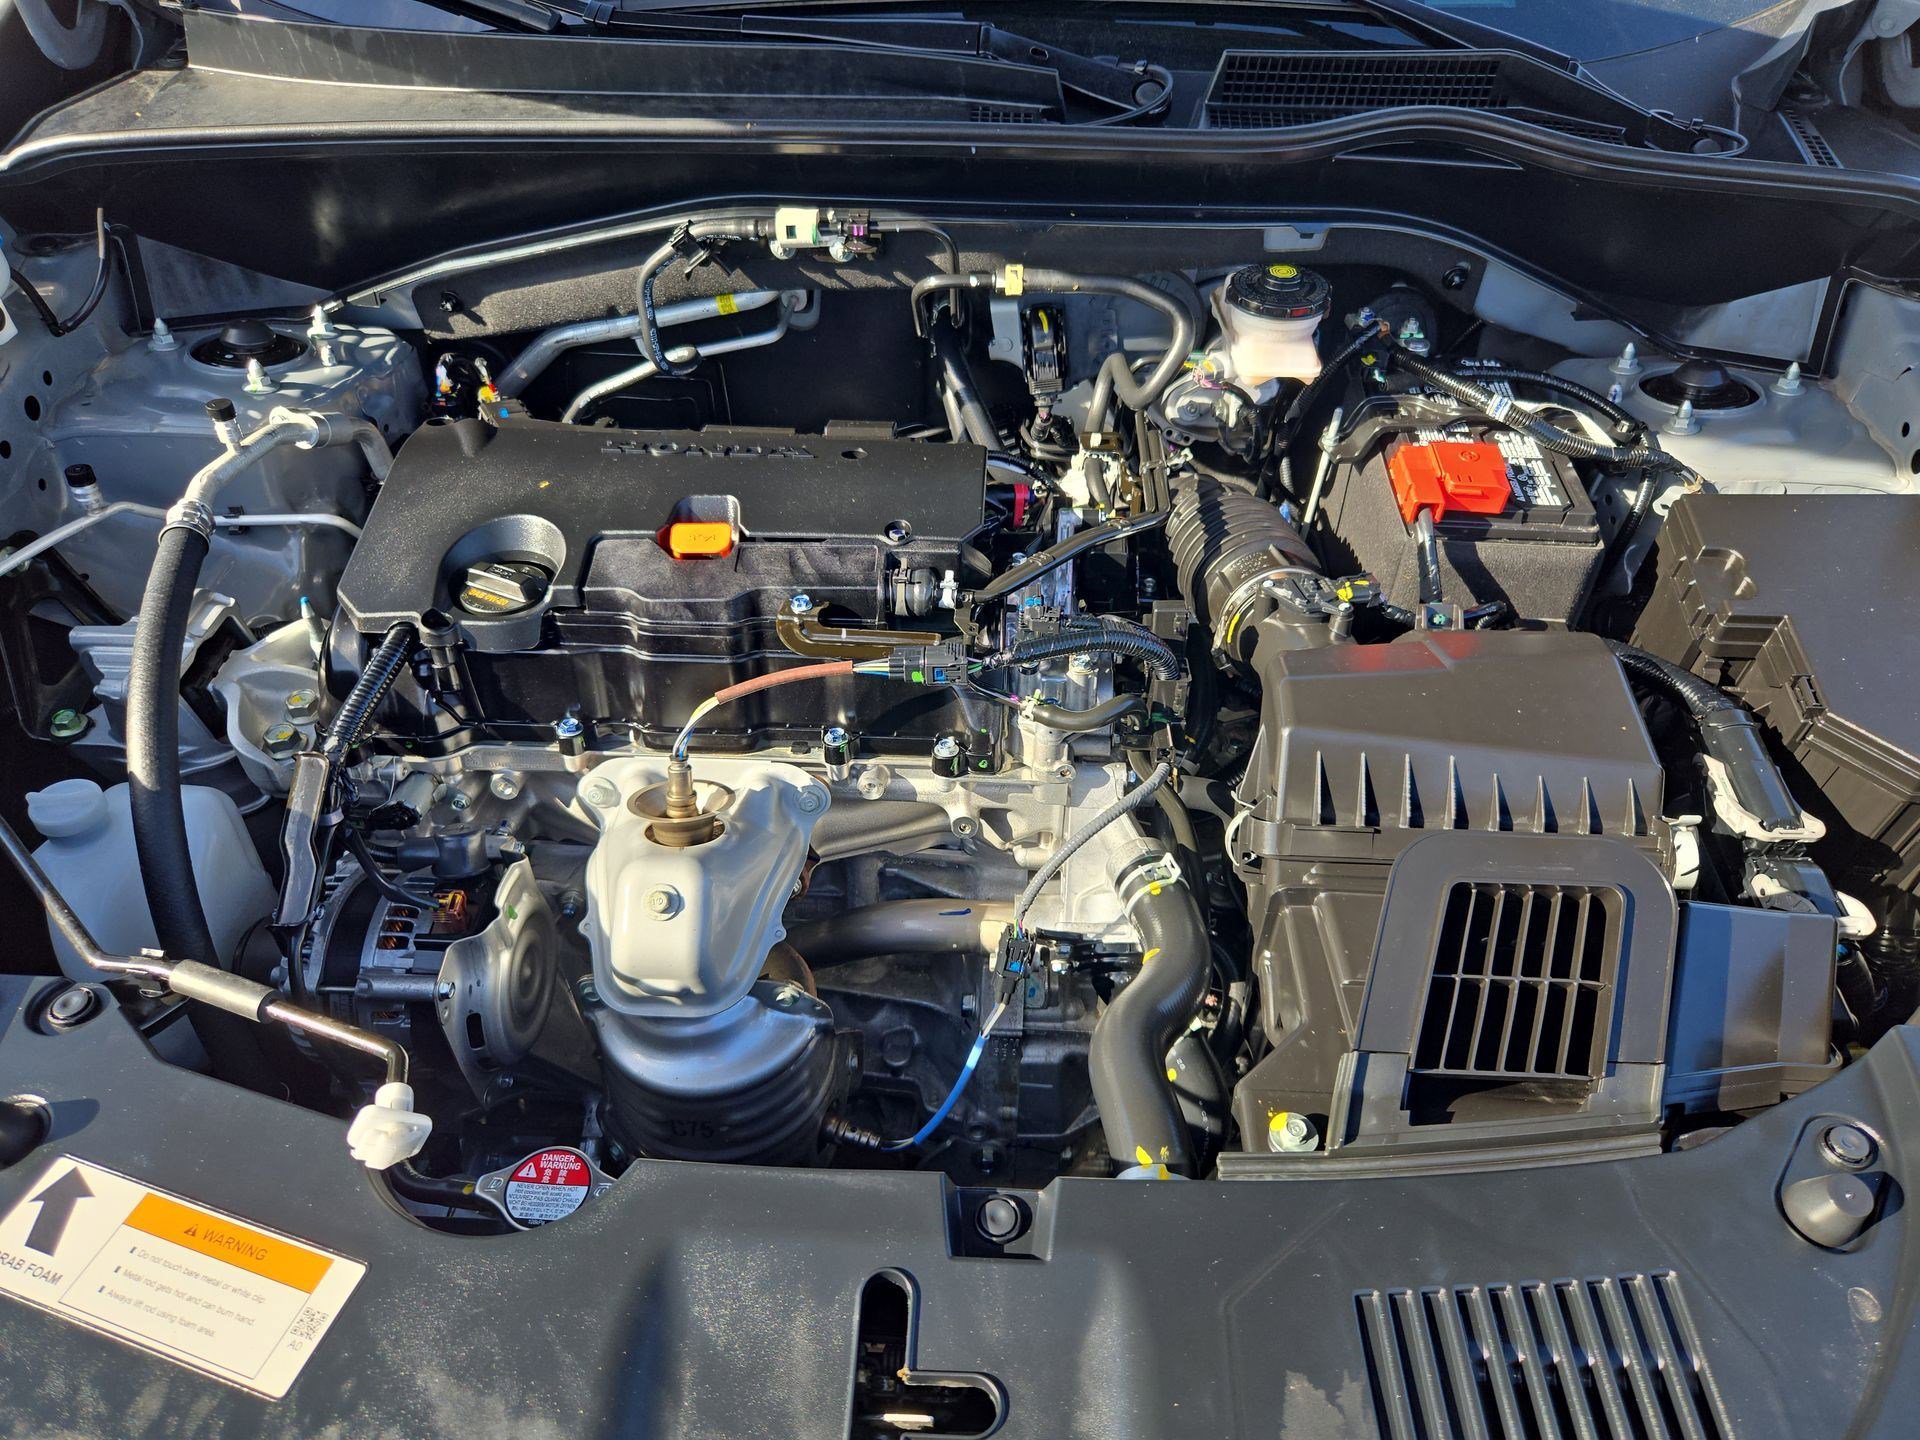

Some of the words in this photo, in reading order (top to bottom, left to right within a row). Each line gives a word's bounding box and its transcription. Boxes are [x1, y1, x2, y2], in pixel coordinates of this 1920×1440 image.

[540, 1160, 581, 1170] WARNUNG
[541, 1153, 576, 1162] DANGER
[202, 1228, 268, 1261] WARNING
[0, 1251, 26, 1270] RAB
[24, 1263, 64, 1286] FOAM
[137, 1249, 149, 1259] Do
[150, 1254, 163, 1265] not
[163, 1258, 183, 1271] touch
[183, 1267, 200, 1279] bare
[200, 1274, 223, 1287] metal
[222, 1282, 232, 1291] or
[232, 1286, 251, 1299] white
[108, 1288, 132, 1305] Always
[132, 1298, 144, 1308] lift
[142, 1304, 158, 1314] rod
[156, 1308, 178, 1324] using
[177, 1316, 198, 1330] foam
[122, 1268, 144, 1282] Metal
[143, 1278, 158, 1288] rod
[155, 1282, 172, 1294] gets
[174, 1288, 187, 1299] hot
[187, 1293, 202, 1304] and
[201, 1300, 216, 1309] can
[216, 1306, 234, 1318] burn
